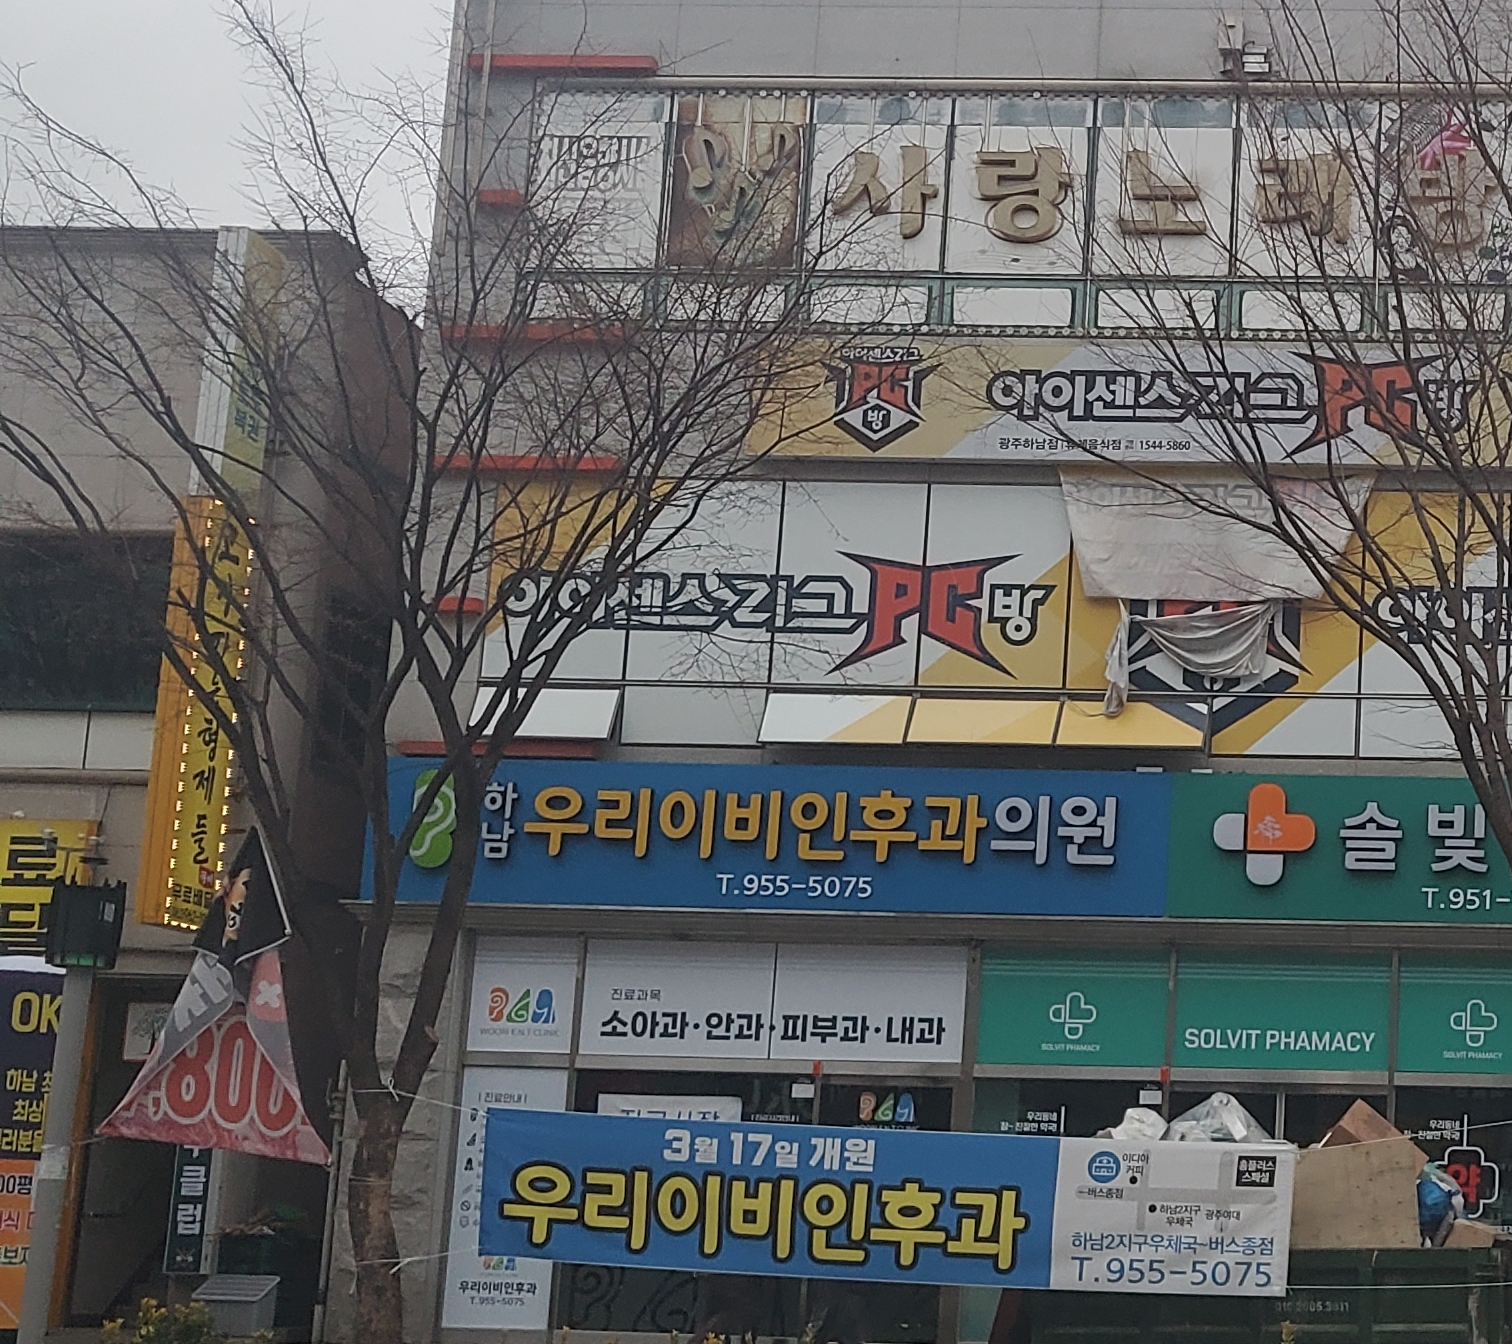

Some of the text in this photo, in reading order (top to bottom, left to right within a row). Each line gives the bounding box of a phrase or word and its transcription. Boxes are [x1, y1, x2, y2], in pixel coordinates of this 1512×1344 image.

[998, 437, 1059, 452] 광주하남점
[1139, 439, 1191, 452] 1544-5860
[522, 785, 1119, 867] 우리이비인후과의원
[716, 872, 873, 899] T.955-5075
[610, 987, 661, 1002] 진료과목
[1184, 1028, 1376, 1053] SOLVIT PHAMACY
[663, 1128, 876, 1172] 3월 17일 개원
[501, 1163, 1027, 1271] 우리이비인후과
[1159, 1203, 1201, 1216] 하남2지구
[1205, 1208, 1241, 1221] 광주여대
[1165, 1216, 1194, 1227] 우체국
[1071, 1256, 1273, 1288] T.955-5075
[458, 1279, 537, 1296] 우리이비인후과
